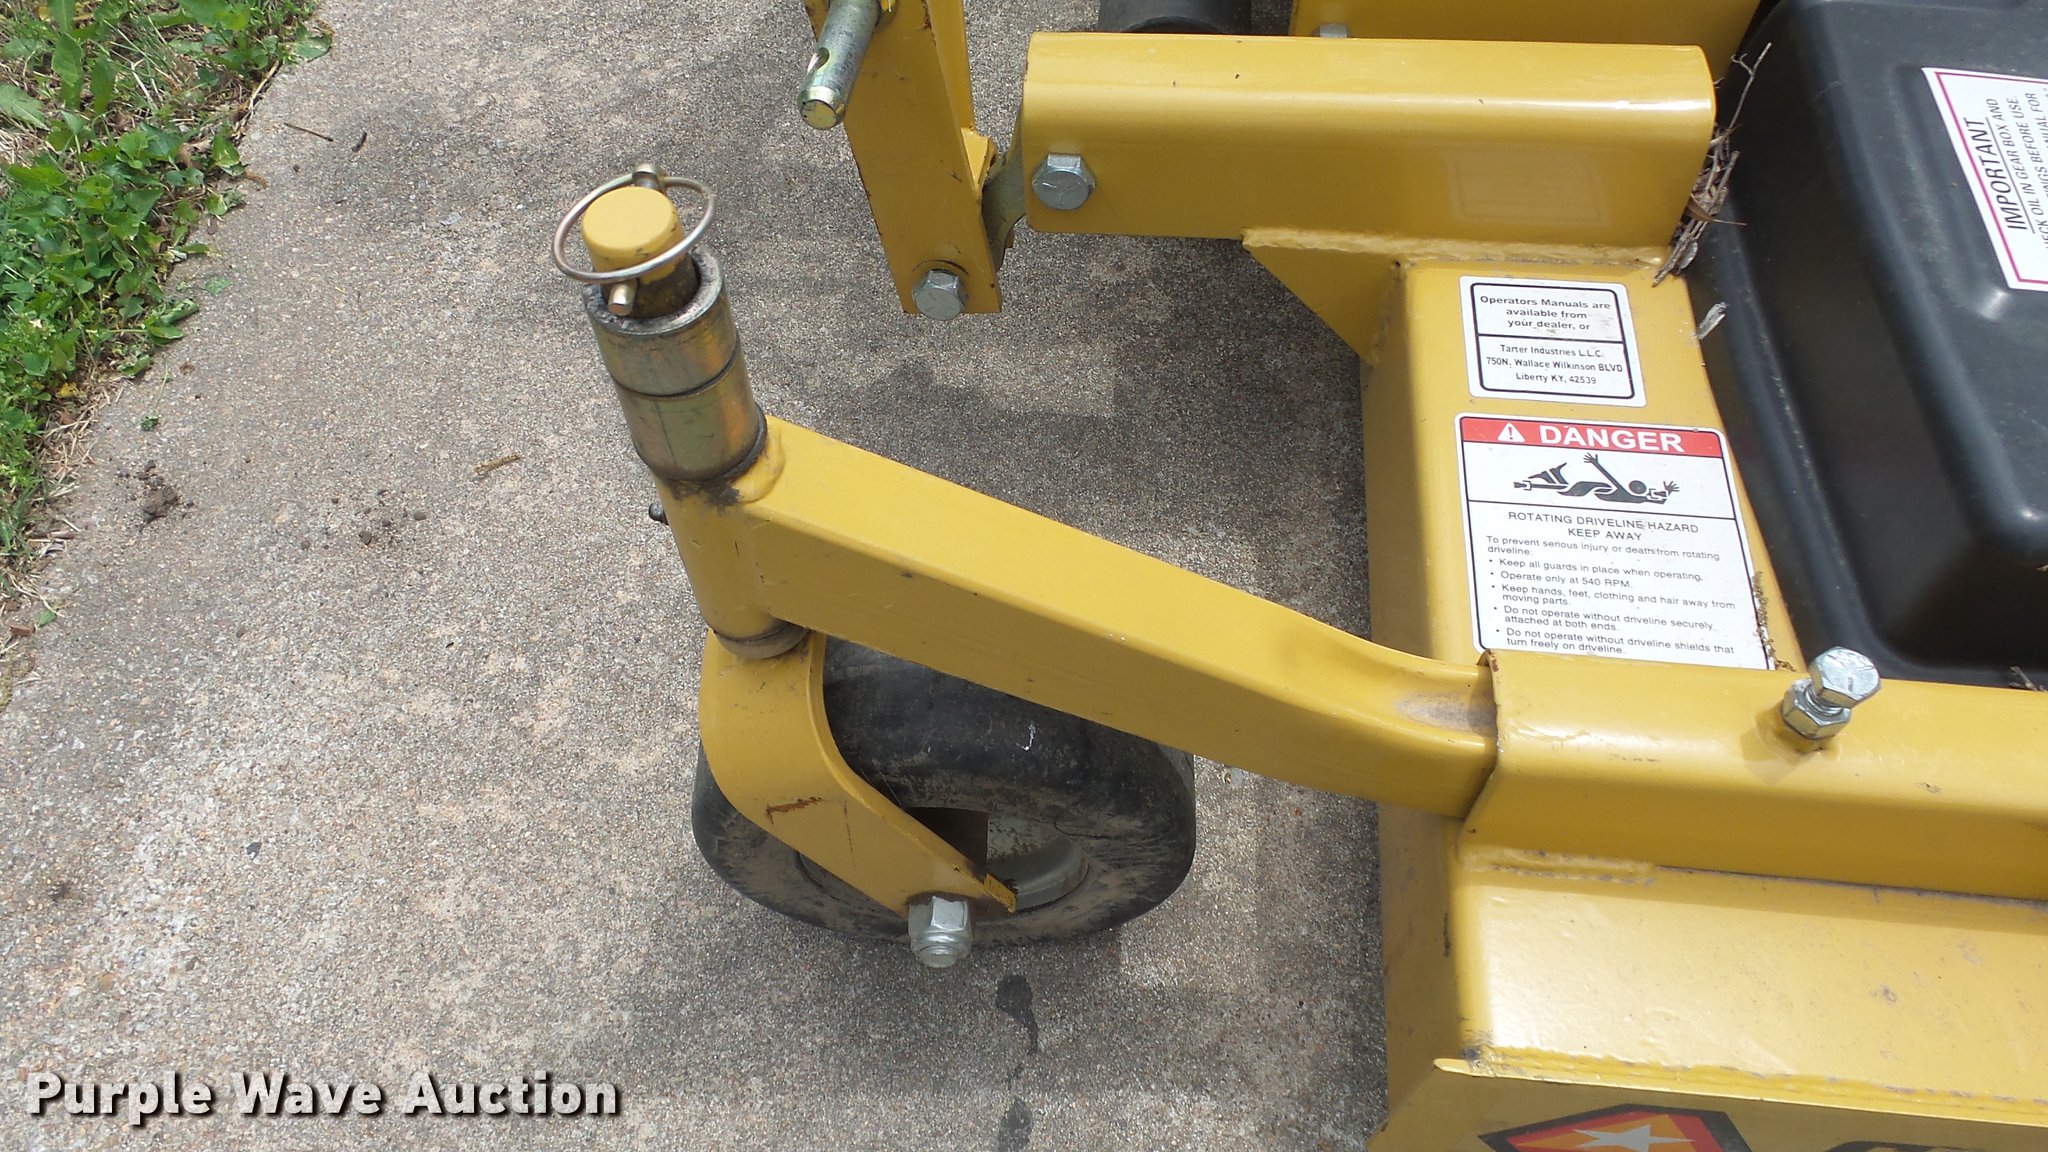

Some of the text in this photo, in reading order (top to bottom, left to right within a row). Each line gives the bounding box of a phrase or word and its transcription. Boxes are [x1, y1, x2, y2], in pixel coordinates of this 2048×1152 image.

[1986, 98, 2005, 120] AND
[2025, 93, 2043, 112] FOR
[1996, 124, 2015, 146] BOX
[2016, 122, 2043, 162] BEFORE
[1963, 117, 2028, 230] IMPORTANT
[2006, 150, 2028, 179] GEAR
[2020, 182, 2036, 194] IN
[2027, 198, 2044, 216] OIL
[1480, 296, 1538, 306] Operators
[1541, 299, 1588, 308] Manuals
[1506, 308, 1588, 318] available from
[1536, 320, 1576, 330] dealer,
[1500, 344, 1528, 354] Tarter
[1531, 346, 1576, 356] Industries
[1514, 359, 1550, 368] Wallace
[1553, 362, 1596, 370] Wilkinson
[1598, 364, 1623, 372] BLVD
[1516, 372, 1548, 383] Liberty
[1569, 376, 1596, 384] 42539
[1539, 425, 1686, 452] DANGER
[1508, 512, 1698, 532] ROTATING DRIVELINE HAZARD
[1568, 528, 1642, 540] KEEP AWAY
[1486, 536, 1499, 544] To
[1502, 538, 1540, 546] prevent
[1542, 540, 1578, 550] serious
[1581, 542, 1608, 552] injury
[1626, 546, 1654, 554] death
[1656, 548, 1679, 556] from
[1682, 551, 1720, 561] rotating
[1499, 558, 1526, 568] Keep
[1529, 560, 1540, 568] all
[1544, 562, 1578, 572] guards
[1592, 565, 1620, 574] place
[1623, 568, 1650, 576] when
[1654, 570, 1703, 582] operating.
[1500, 570, 1542, 580] Operate
[1545, 575, 1566, 584] only
[1582, 578, 1600, 586] 540
[1502, 584, 1528, 594] Keep
[1532, 586, 1566, 596] hands,
[1594, 591, 1634, 602] clothing
[1638, 595, 1657, 604] and
[1660, 596, 1679, 605] hair
[1682, 599, 1708, 608] away
[1712, 600, 1736, 610] from
[1502, 594, 1539, 605] moving
[1504, 605, 1518, 614] Do
[1522, 608, 1538, 616] not
[1542, 610, 1580, 619] operate
[1583, 612, 1620, 622] without
[1624, 616, 1667, 626] driveline
[1505, 616, 1550, 626] attached
[1565, 620, 1588, 629] both
[1506, 628, 1735, 654] Do not operate without driveline shields that
[1507, 638, 1528, 646] turn
[1530, 639, 1560, 650] freely
[1562, 642, 1576, 650] on
